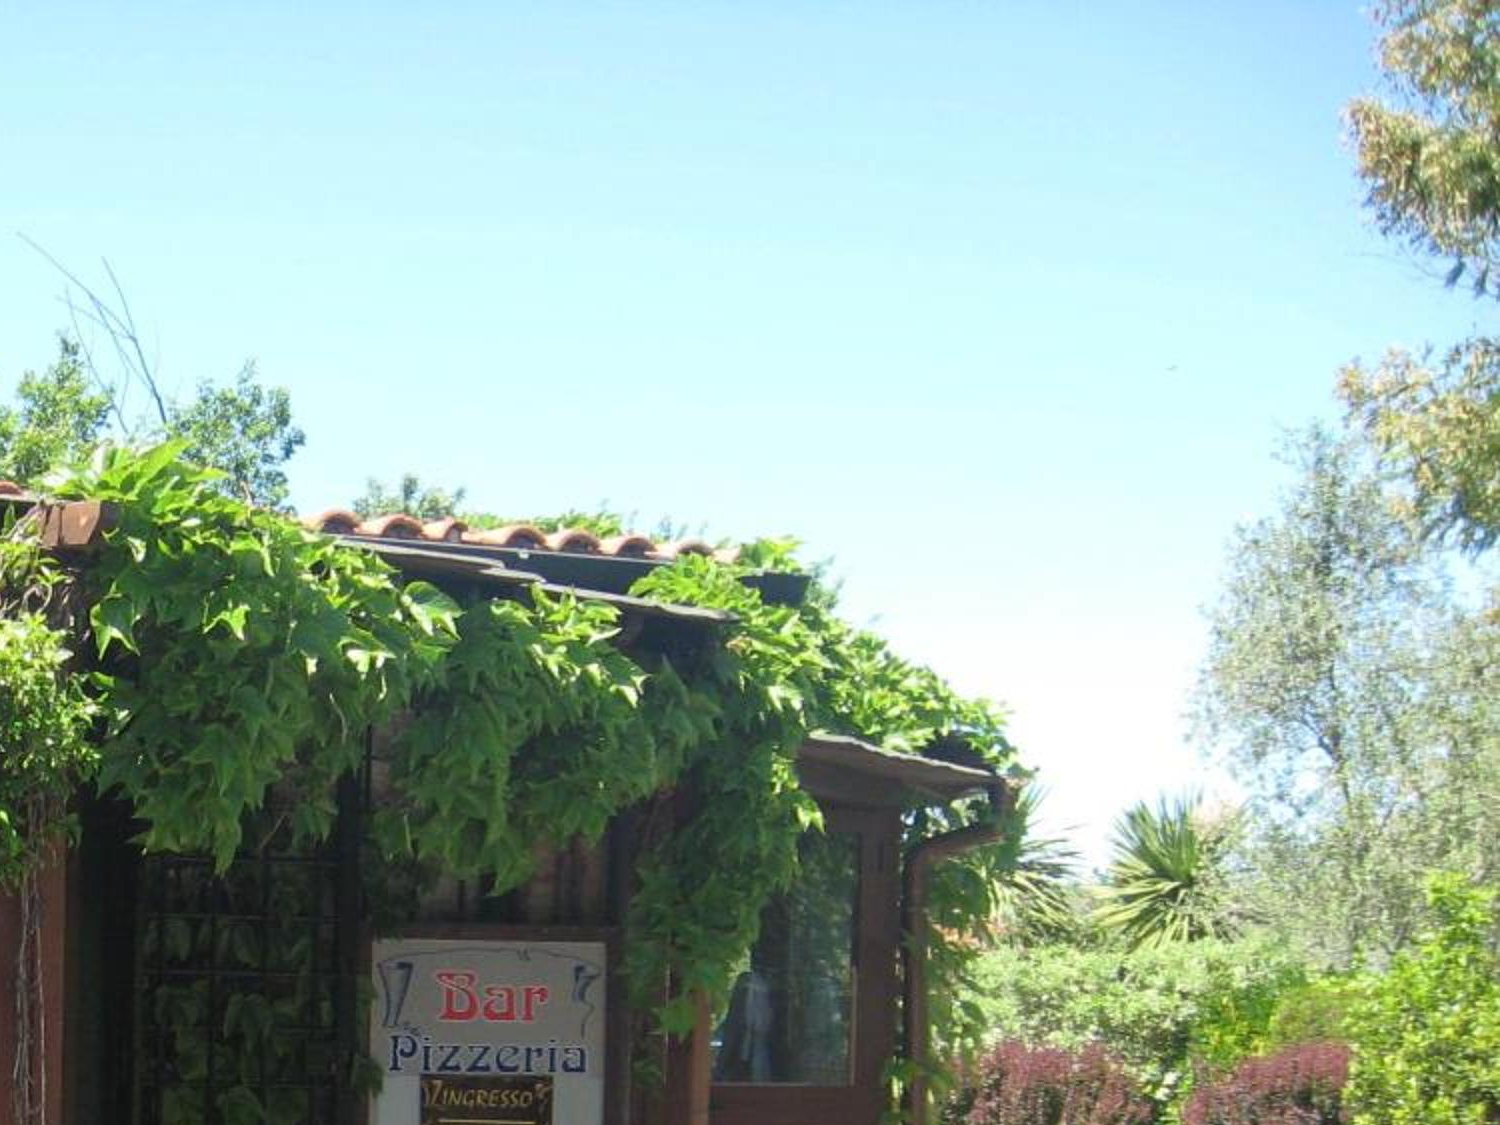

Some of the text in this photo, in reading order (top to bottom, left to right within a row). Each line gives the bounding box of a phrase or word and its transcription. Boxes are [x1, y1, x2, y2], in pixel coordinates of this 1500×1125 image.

[435, 971, 550, 1022] Bar
[388, 1034, 588, 1073] Pizzeria
[440, 1088, 534, 1109] INGRESSO
